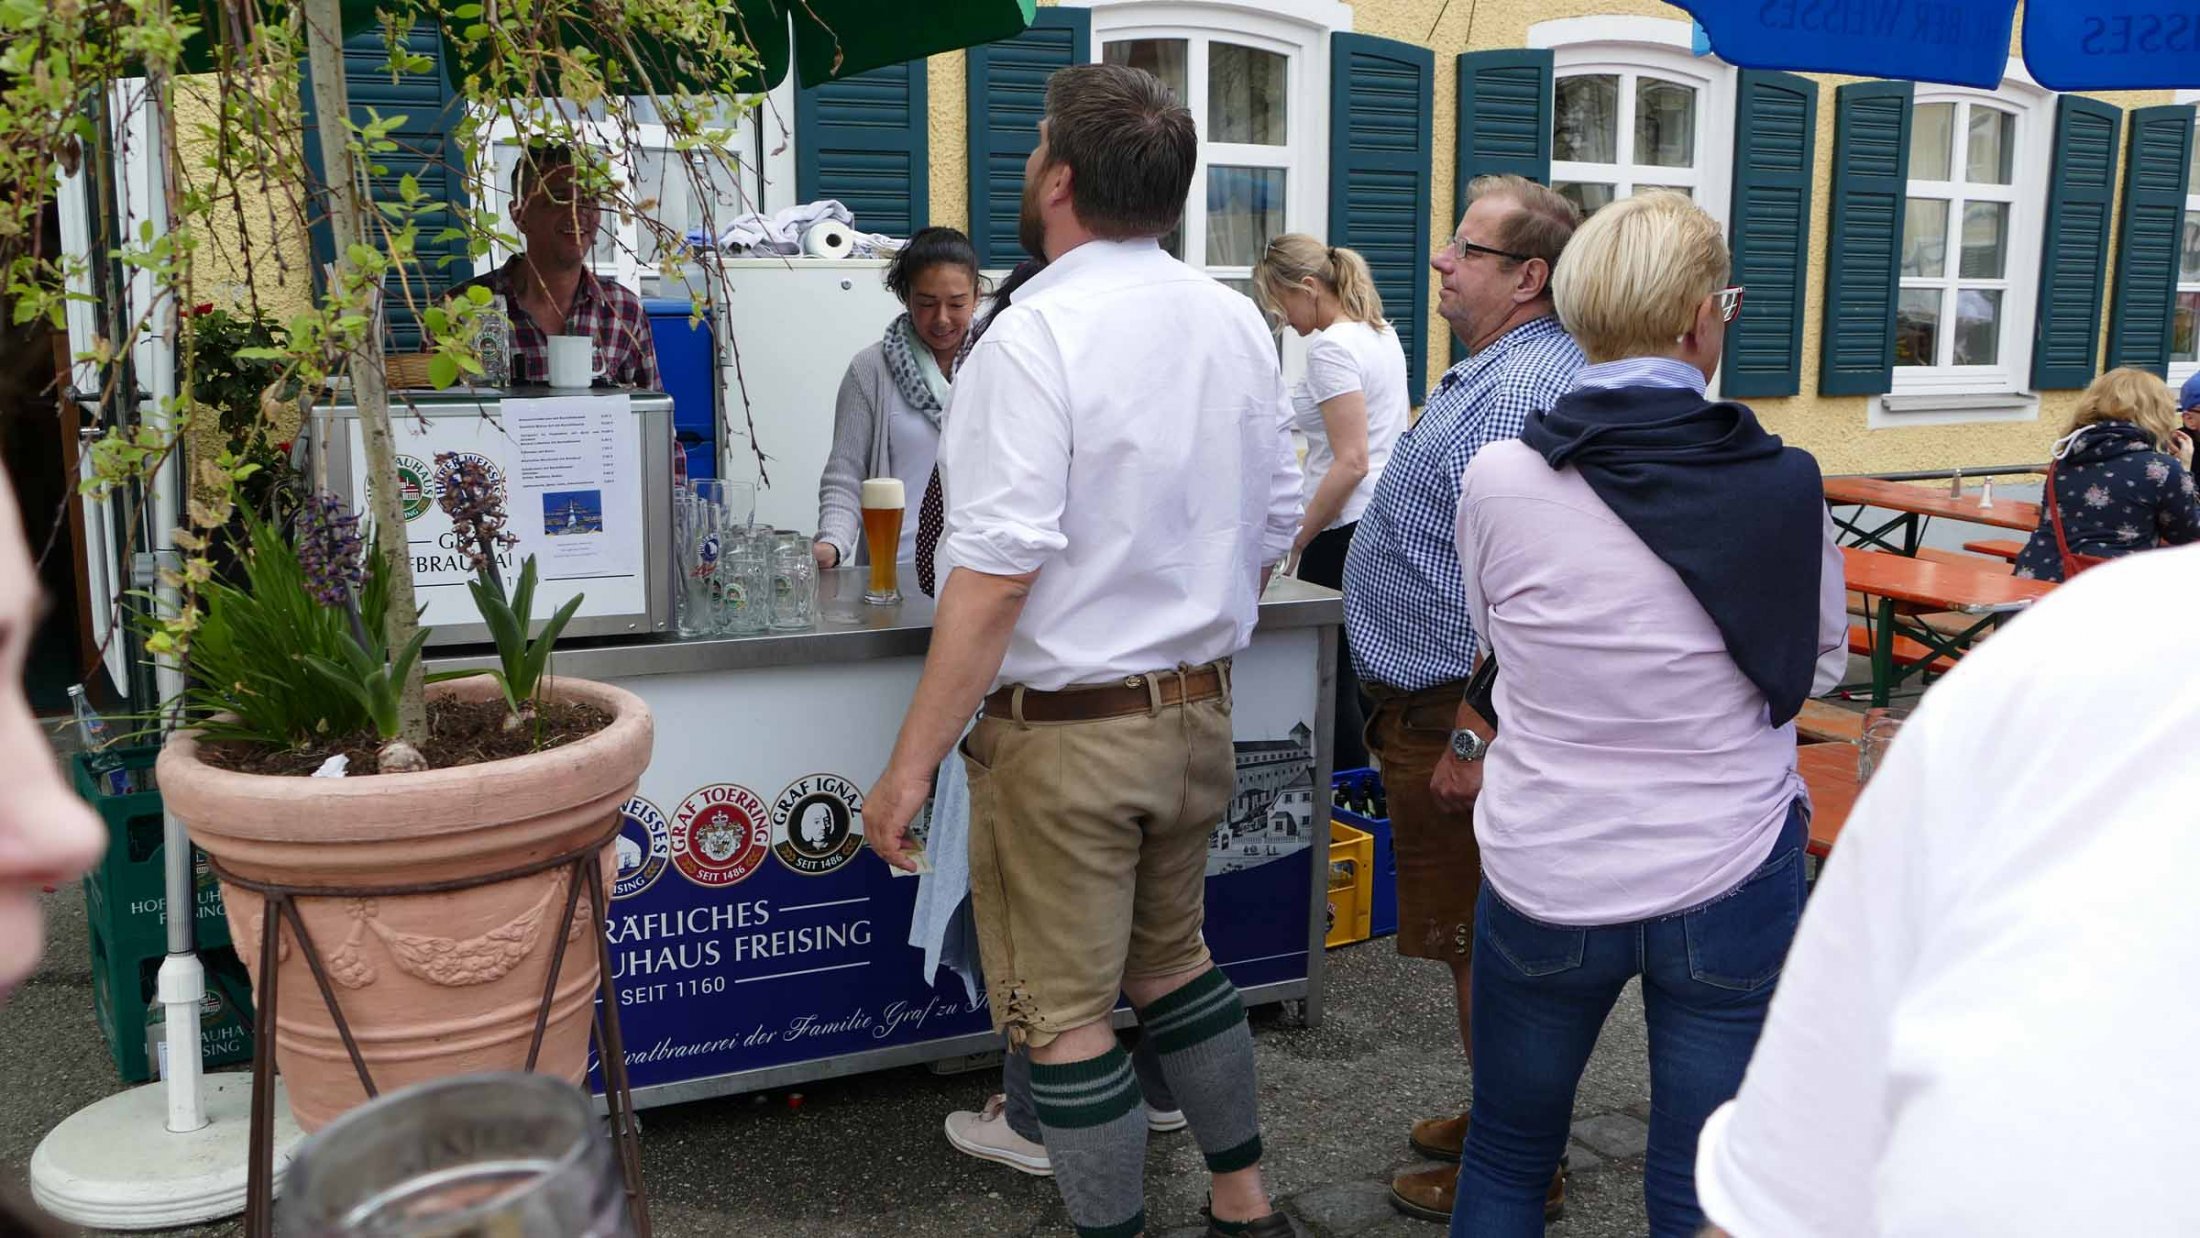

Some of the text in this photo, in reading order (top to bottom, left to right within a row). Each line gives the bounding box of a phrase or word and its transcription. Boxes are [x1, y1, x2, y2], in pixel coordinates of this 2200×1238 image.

[394, 456, 434, 498] AUHAUS
[671, 787, 769, 853] GRAF TOERRING
[772, 780, 810, 826] GRAF
[697, 865, 746, 882] SEIT 1486
[795, 853, 843, 871] SEIT 1486
[604, 899, 770, 945] RÄFLICHES
[611, 919, 872, 979] UHAUS FREISING
[620, 975, 726, 1006] SEIT 1160
[743, 1023, 778, 1048] der
[782, 1007, 873, 1043] Familie
[872, 995, 941, 1039] Graf
[935, 1002, 958, 1017] zu
